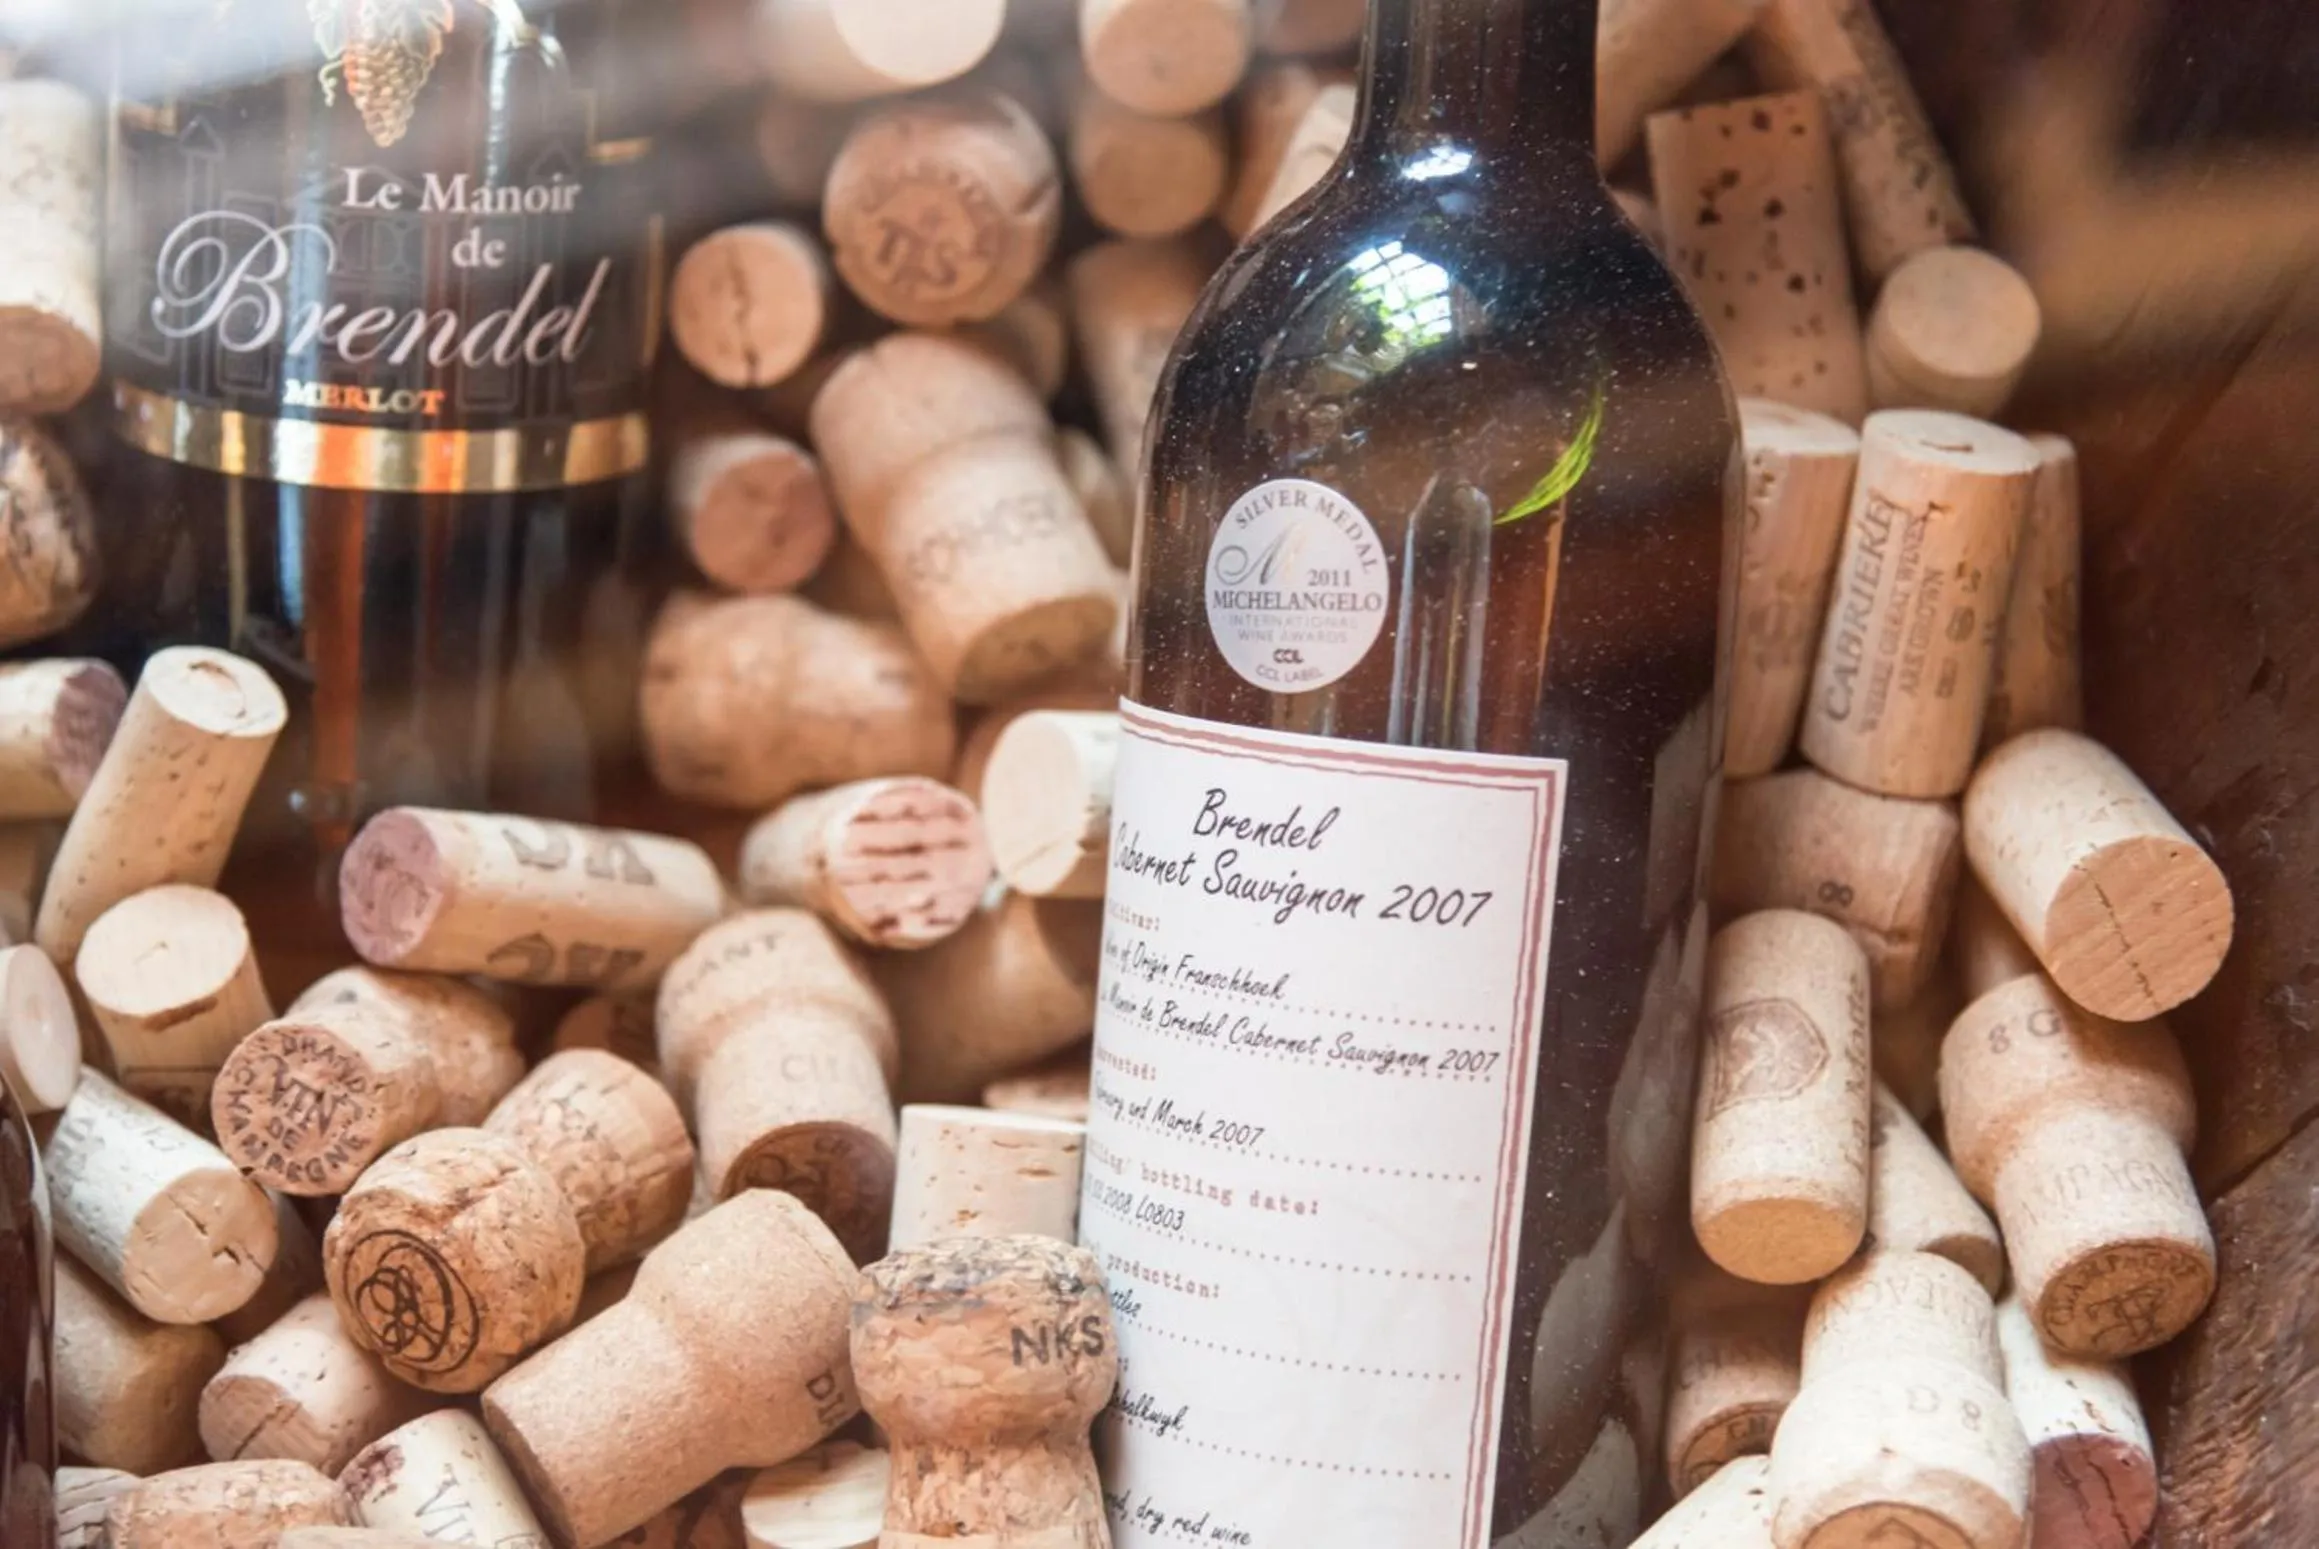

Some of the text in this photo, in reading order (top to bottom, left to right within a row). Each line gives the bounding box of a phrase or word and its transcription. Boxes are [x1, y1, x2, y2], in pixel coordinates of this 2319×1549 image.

[343, 167, 581, 214] Le Manoir
[451, 227, 506, 269] de
[151, 209, 610, 368] Brendel
[282, 377, 445, 415] MERLOT
[1235, 489, 1379, 575] SILVER MEDAL
[1212, 588, 1382, 612] MICHELANGELO
[1307, 568, 1352, 588] 2011
[1192, 788, 1341, 851] Brendel
[1114, 822, 1493, 928] Cabernet Sauvignon 2007
[1132, 940, 1170, 982] Origin
[1158, 1000, 1229, 1038] Brendel
[1228, 1015, 1321, 1056] Cabernet
[1327, 1031, 1430, 1075] Sauvignon
[1437, 1048, 1500, 1073] 2007
[1152, 1099, 1206, 1136] March
[1208, 1118, 1266, 1147] 2007
[1140, 1160, 1233, 1208] bottling
[1249, 1189, 1319, 1216] date:
[1135, 1193, 1186, 1232] L0803
[1106, 1253, 1221, 1299] production:
[1010, 1314, 1106, 1367] NKS
[1136, 1496, 1165, 1536] dry
[1172, 1511, 1211, 1536] red
[1211, 1522, 1251, 1547] wine
